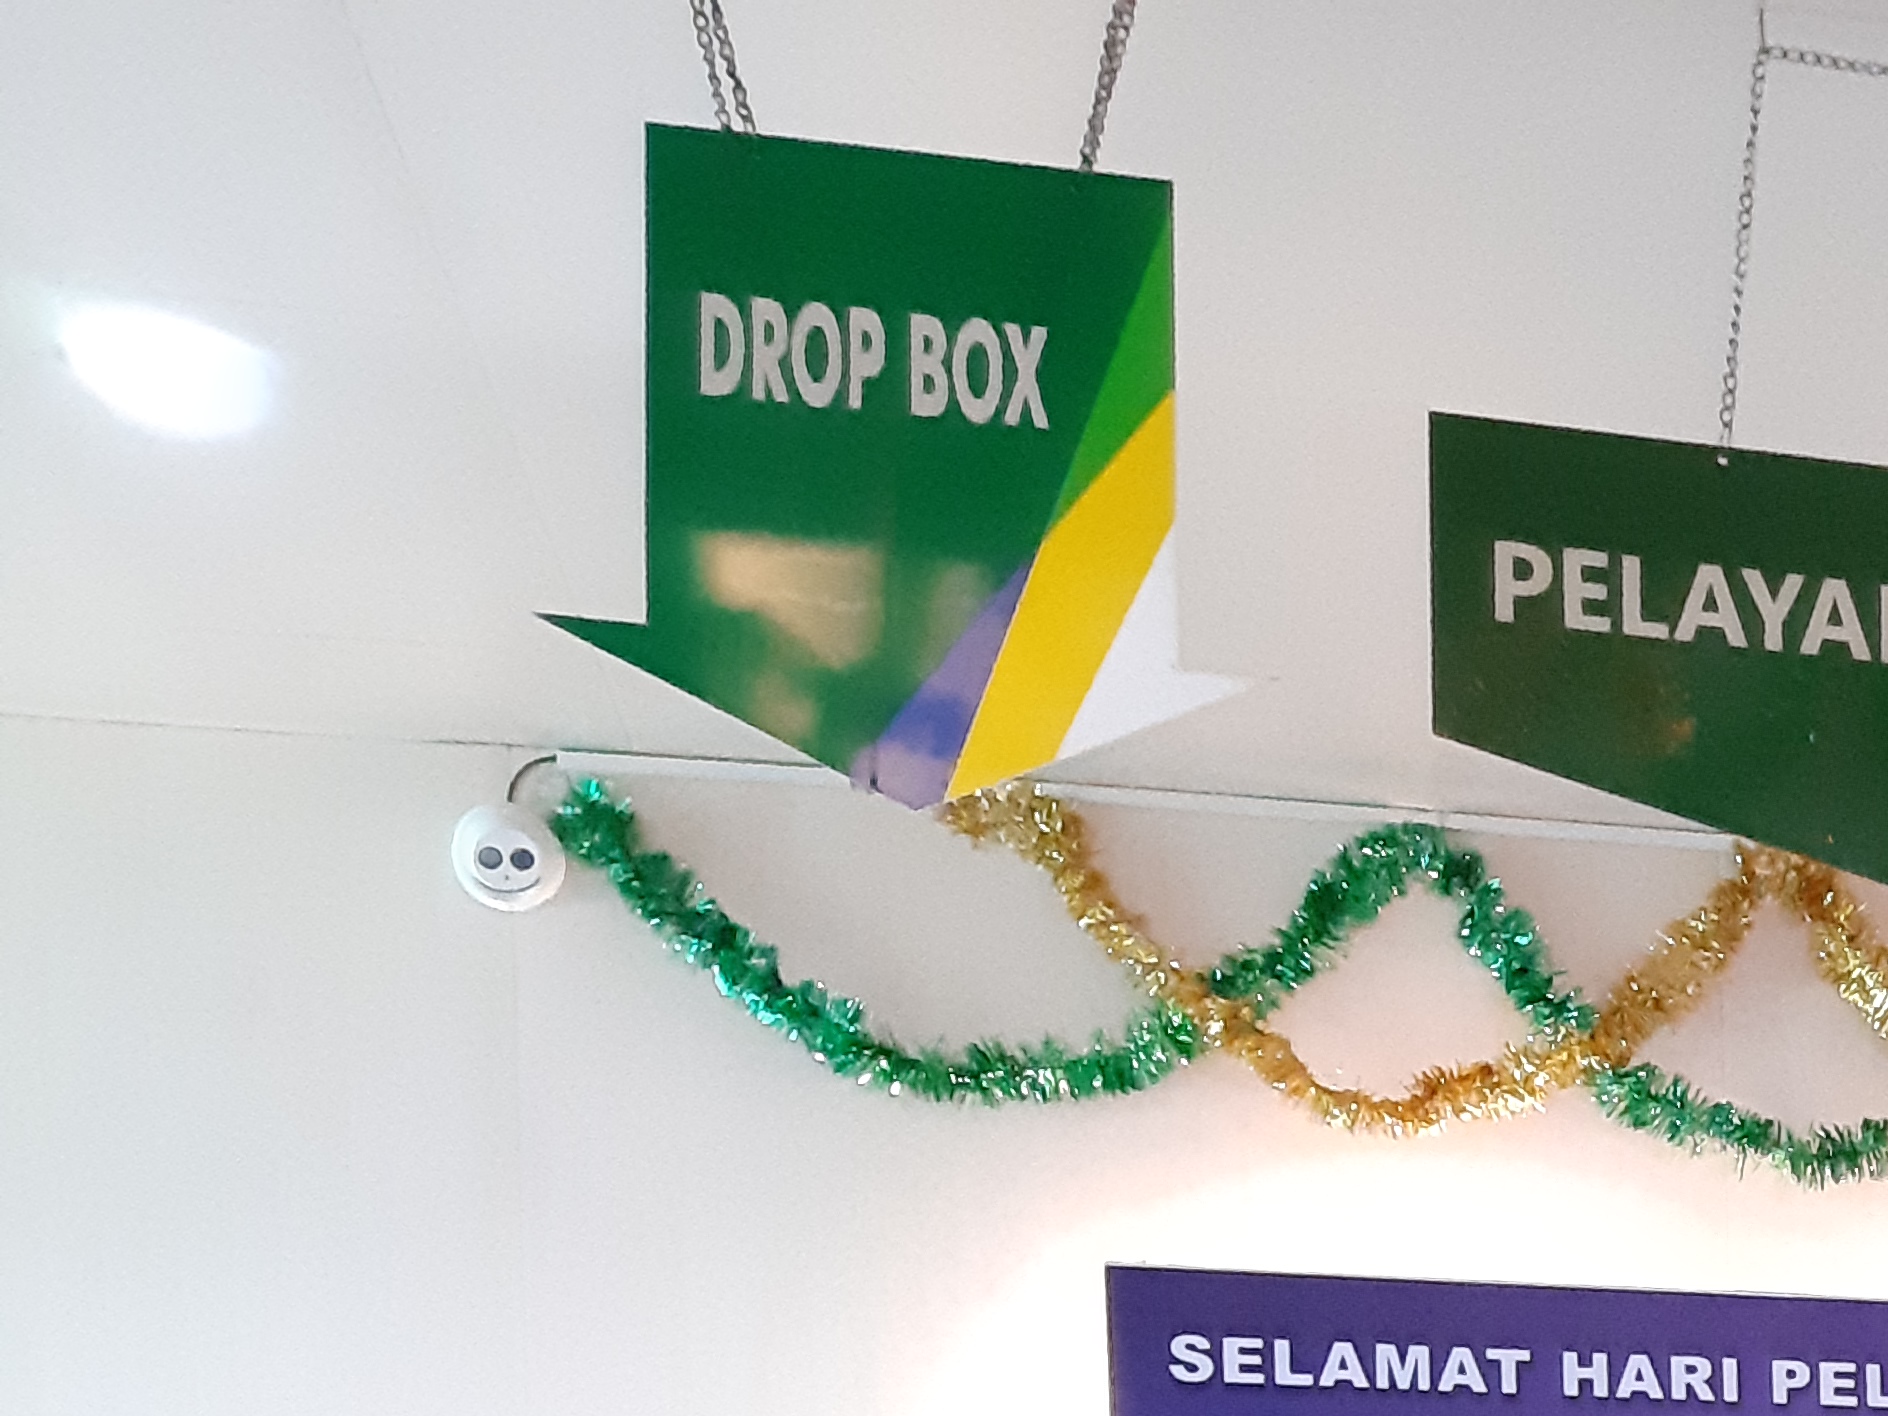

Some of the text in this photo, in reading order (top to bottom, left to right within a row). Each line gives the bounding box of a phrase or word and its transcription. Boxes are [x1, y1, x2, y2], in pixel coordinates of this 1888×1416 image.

[699, 290, 1050, 430] DROP BOX
[1167, 1332, 1532, 1395] SELAMAT
[1561, 1350, 1740, 1403] HARI
